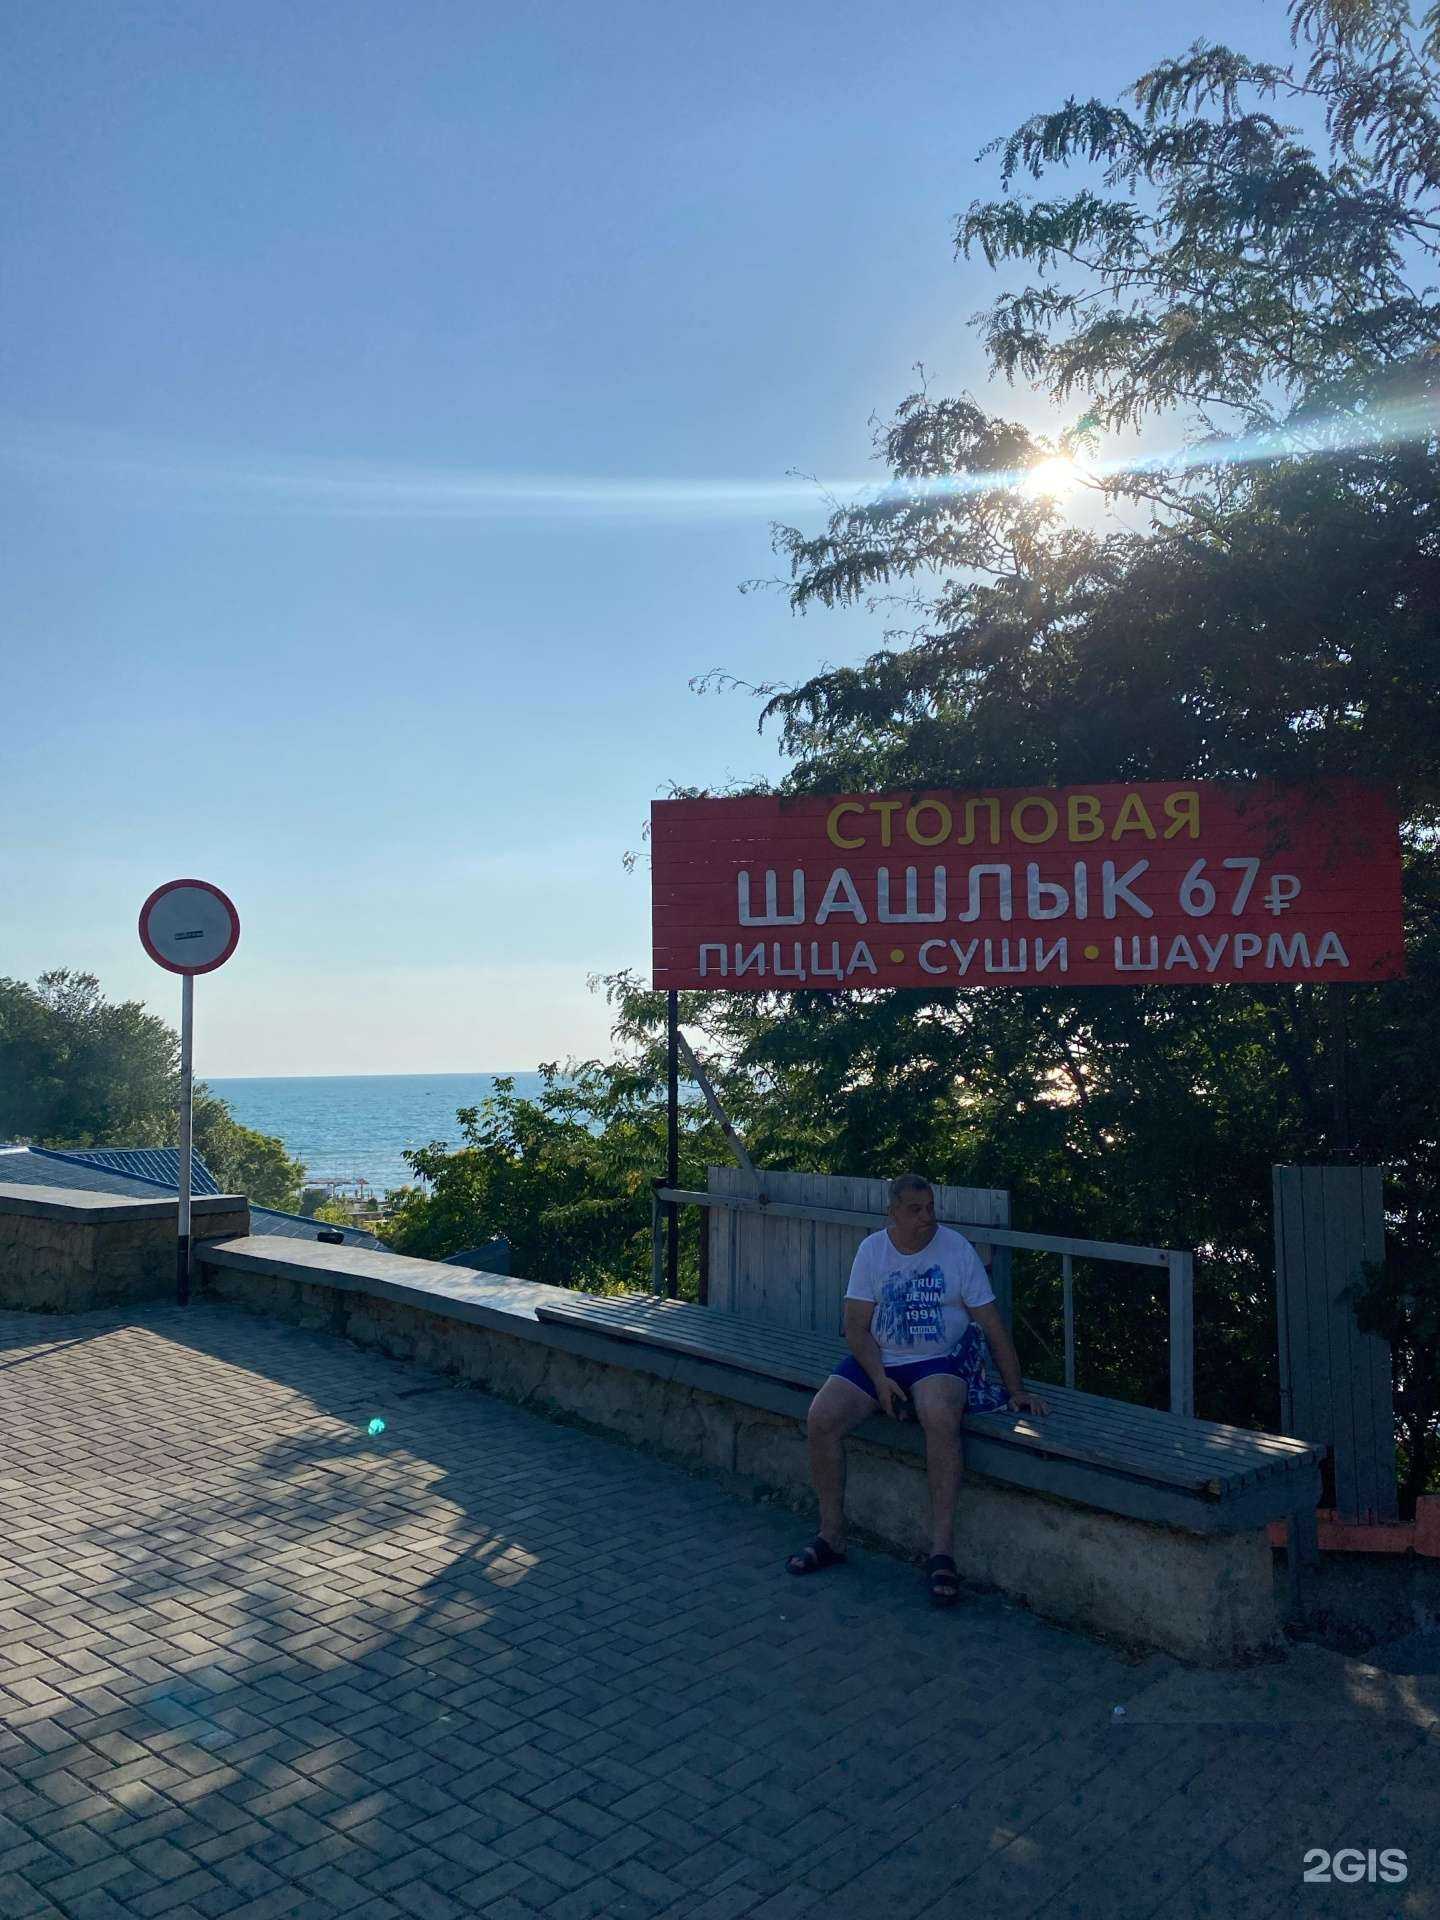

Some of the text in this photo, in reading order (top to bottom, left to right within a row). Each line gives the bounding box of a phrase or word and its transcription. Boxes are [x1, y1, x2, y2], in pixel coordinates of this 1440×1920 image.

[826, 791, 1201, 849] СТОЛОВАЯ
[737, 858, 1154, 927] ШАШЛЫК
[699, 930, 1350, 982] ПИЦЦА СУШИ ШАУРМА
[906, 1291, 944, 1302] DENIM
[911, 1278, 943, 1288] TRUE
[906, 1309, 938, 1320] 1994
